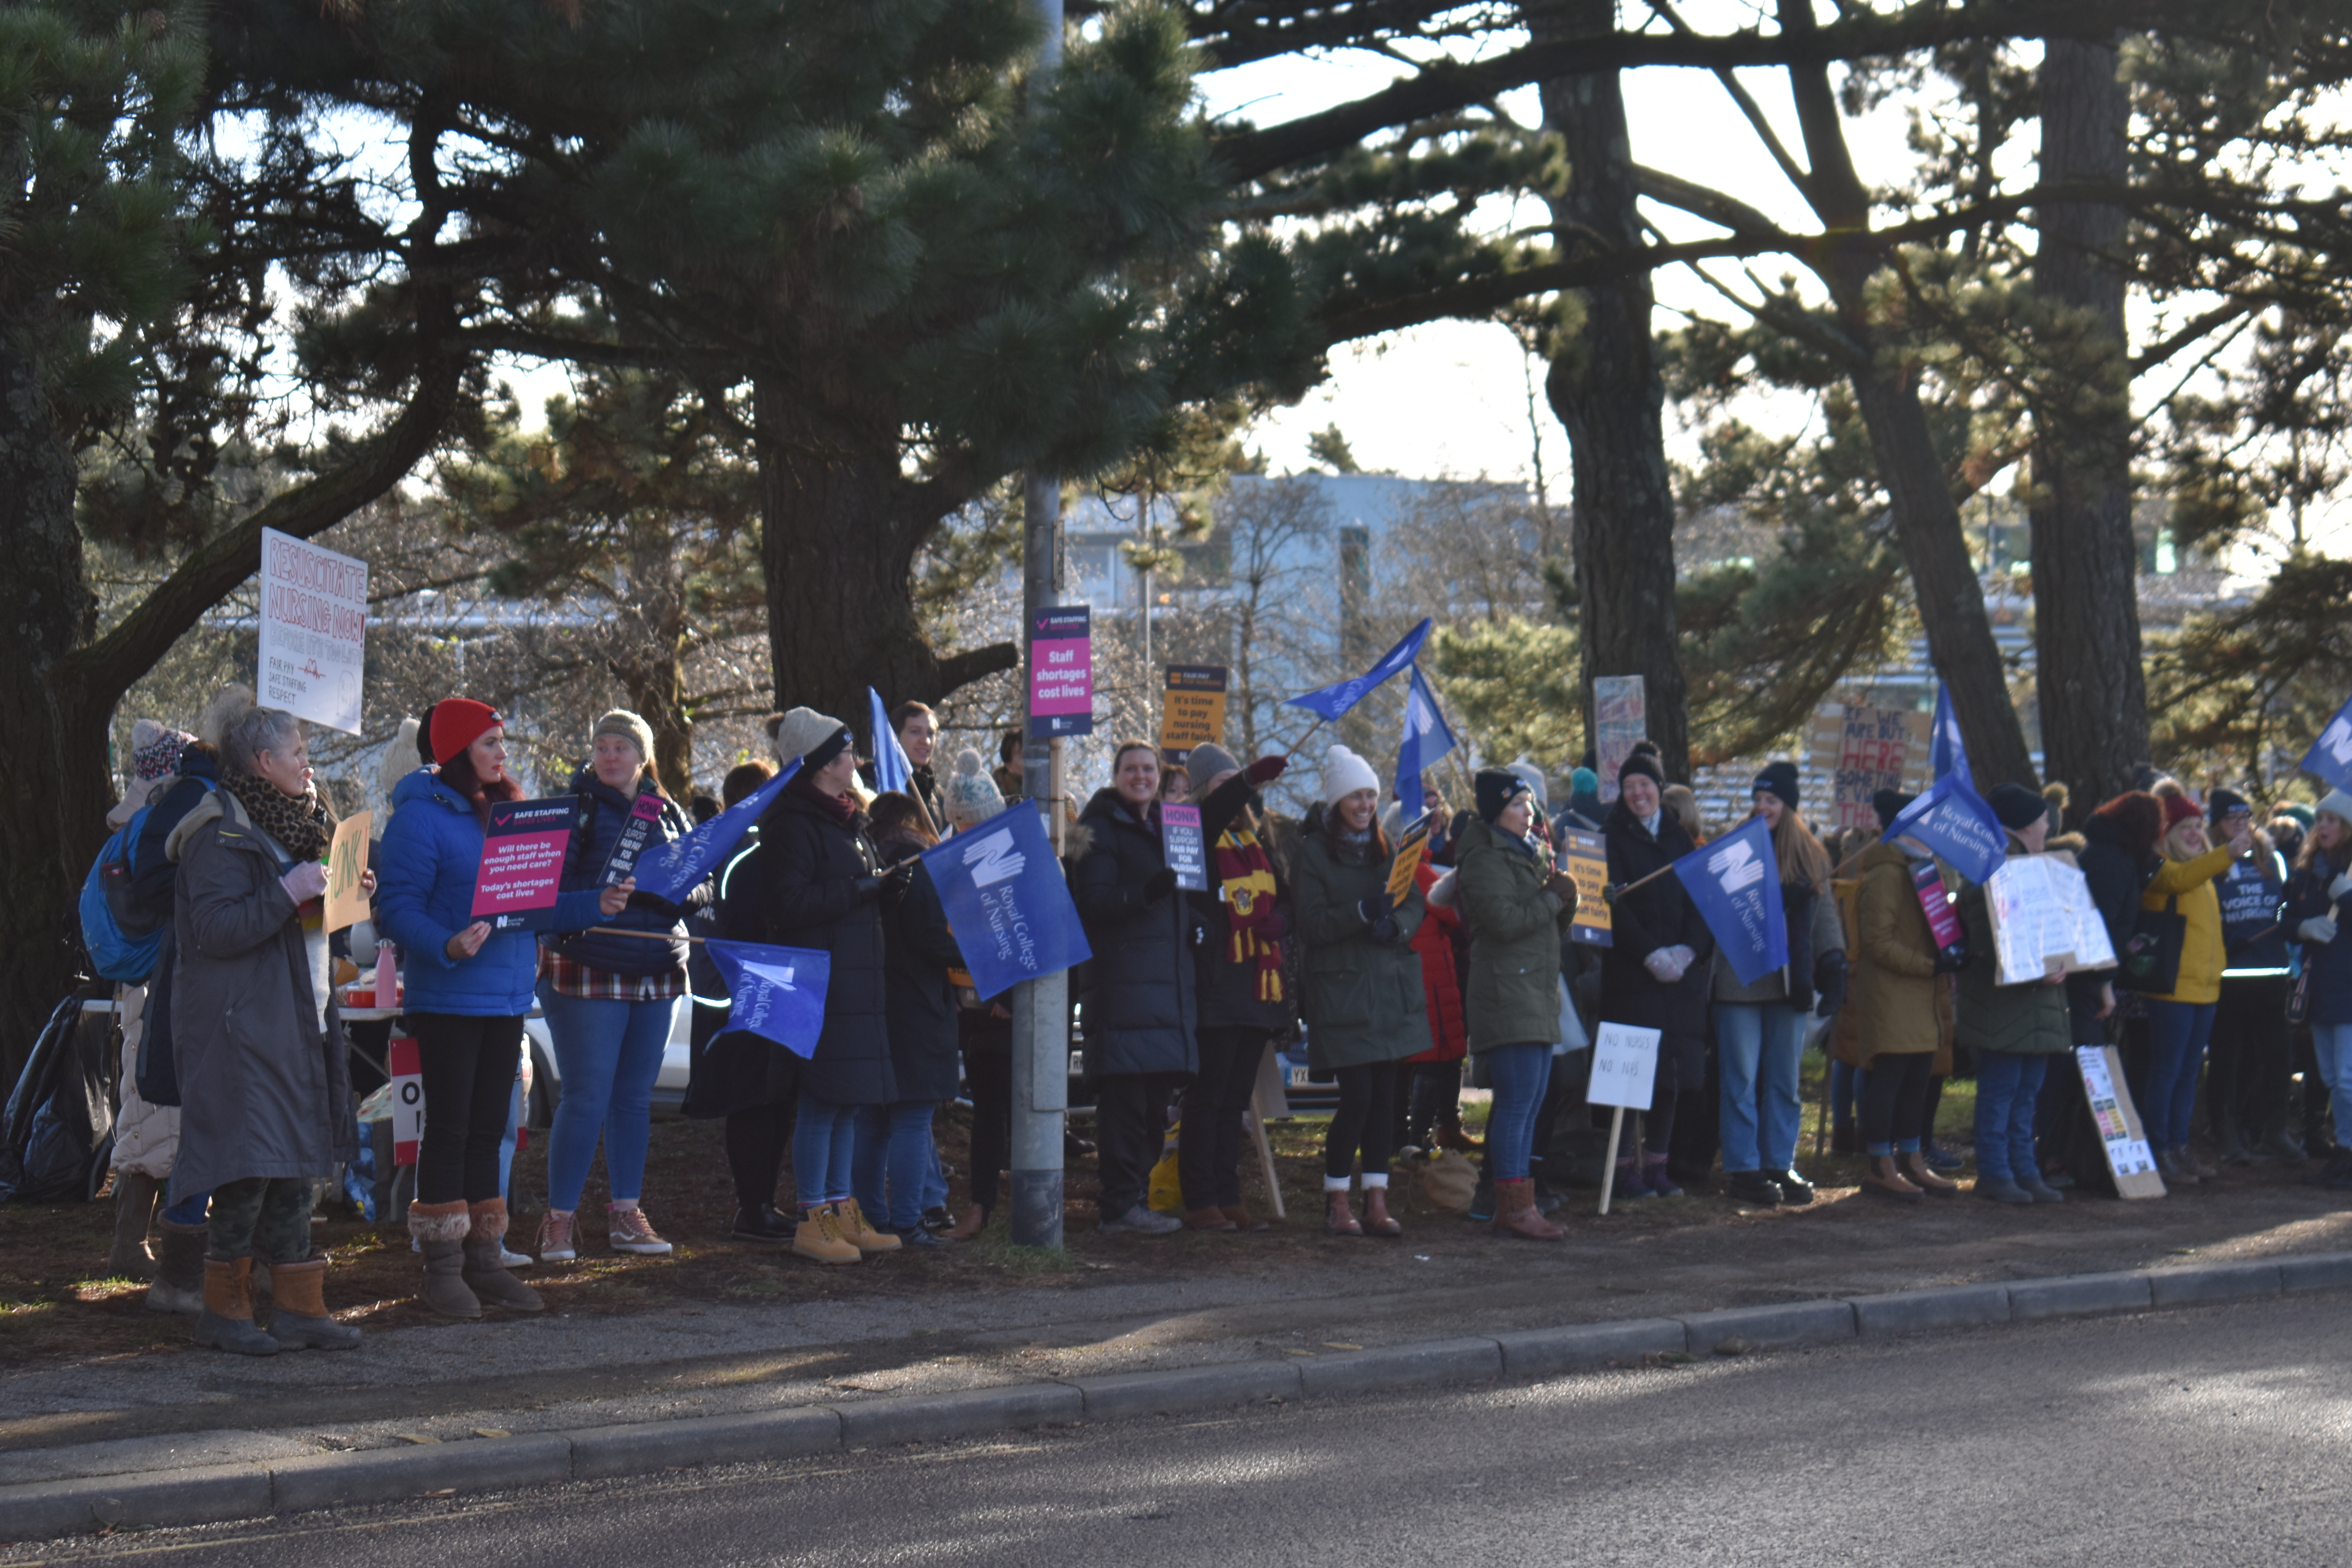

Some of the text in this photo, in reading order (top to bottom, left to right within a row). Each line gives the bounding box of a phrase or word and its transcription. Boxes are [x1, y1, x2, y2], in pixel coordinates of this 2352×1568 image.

[270, 537, 365, 604] RESUSCITATE
[269, 583, 365, 648] NURSING NOW!
[270, 621, 305, 654] BEFORE
[307, 634, 324, 658] IT'S
[325, 640, 341, 662] TOO
[1049, 649, 1074, 663] Staff
[269, 656, 294, 675] FAIR PAY
[269, 671, 306, 693] SAFE STAFFING
[1036, 669, 1087, 682] shortages
[269, 685, 296, 705] RESPECT
[1038, 684, 1085, 699] cost lives
[1174, 695, 1214, 705] It's time
[1190, 710, 1208, 719] pay
[1876, 709, 1902, 725] WE
[1173, 720, 1210, 731] nursing
[1166, 731, 1216, 742] staff fairly
[1843, 739, 1904, 771] HERE
[534, 808, 570, 817] STAFFING
[635, 799, 662, 817] HONK
[1837, 802, 1881, 828] THE
[513, 817, 535, 826] SAVES
[1165, 809, 1196, 823] HONK
[1941, 805, 1975, 829] Royal
[632, 818, 649, 831] IF YOU
[1172, 826, 1193, 836] IF YOU
[624, 828, 647, 841] SUPPORT
[1169, 835, 1198, 845] SUPPORT
[1933, 822, 1990, 860] of Nursing
[499, 841, 551, 854] Will there be
[620, 838, 642, 852] FAIR PAY
[1170, 844, 1199, 855] FAIR PAY
[484, 850, 561, 865] enough staff when
[620, 849, 632, 860] FOR
[1178, 854, 1192, 863] FOR
[489, 859, 552, 875] you need care?
[610, 858, 633, 872] NURSING
[1171, 863, 1201, 874] NURSING
[1586, 865, 1601, 877] time
[481, 877, 554, 893] Today's shortages
[1578, 878, 1599, 892] to pay
[2237, 882, 2264, 896] THE
[496, 889, 535, 900] cost lives
[1581, 892, 1603, 906] ursing
[1746, 888, 1765, 920] Royal
[2222, 895, 2262, 910] VOICE
[1577, 906, 1607, 920] taff fairly
[980, 893, 1013, 961] of Nursing
[999, 885, 1038, 971] Royal College
[1731, 896, 1766, 952] of Nursing
[745, 1003, 770, 1029] College
[1604, 1032, 1650, 1049] NO NURSES
[1598, 1059, 1640, 1076] NO NHS
